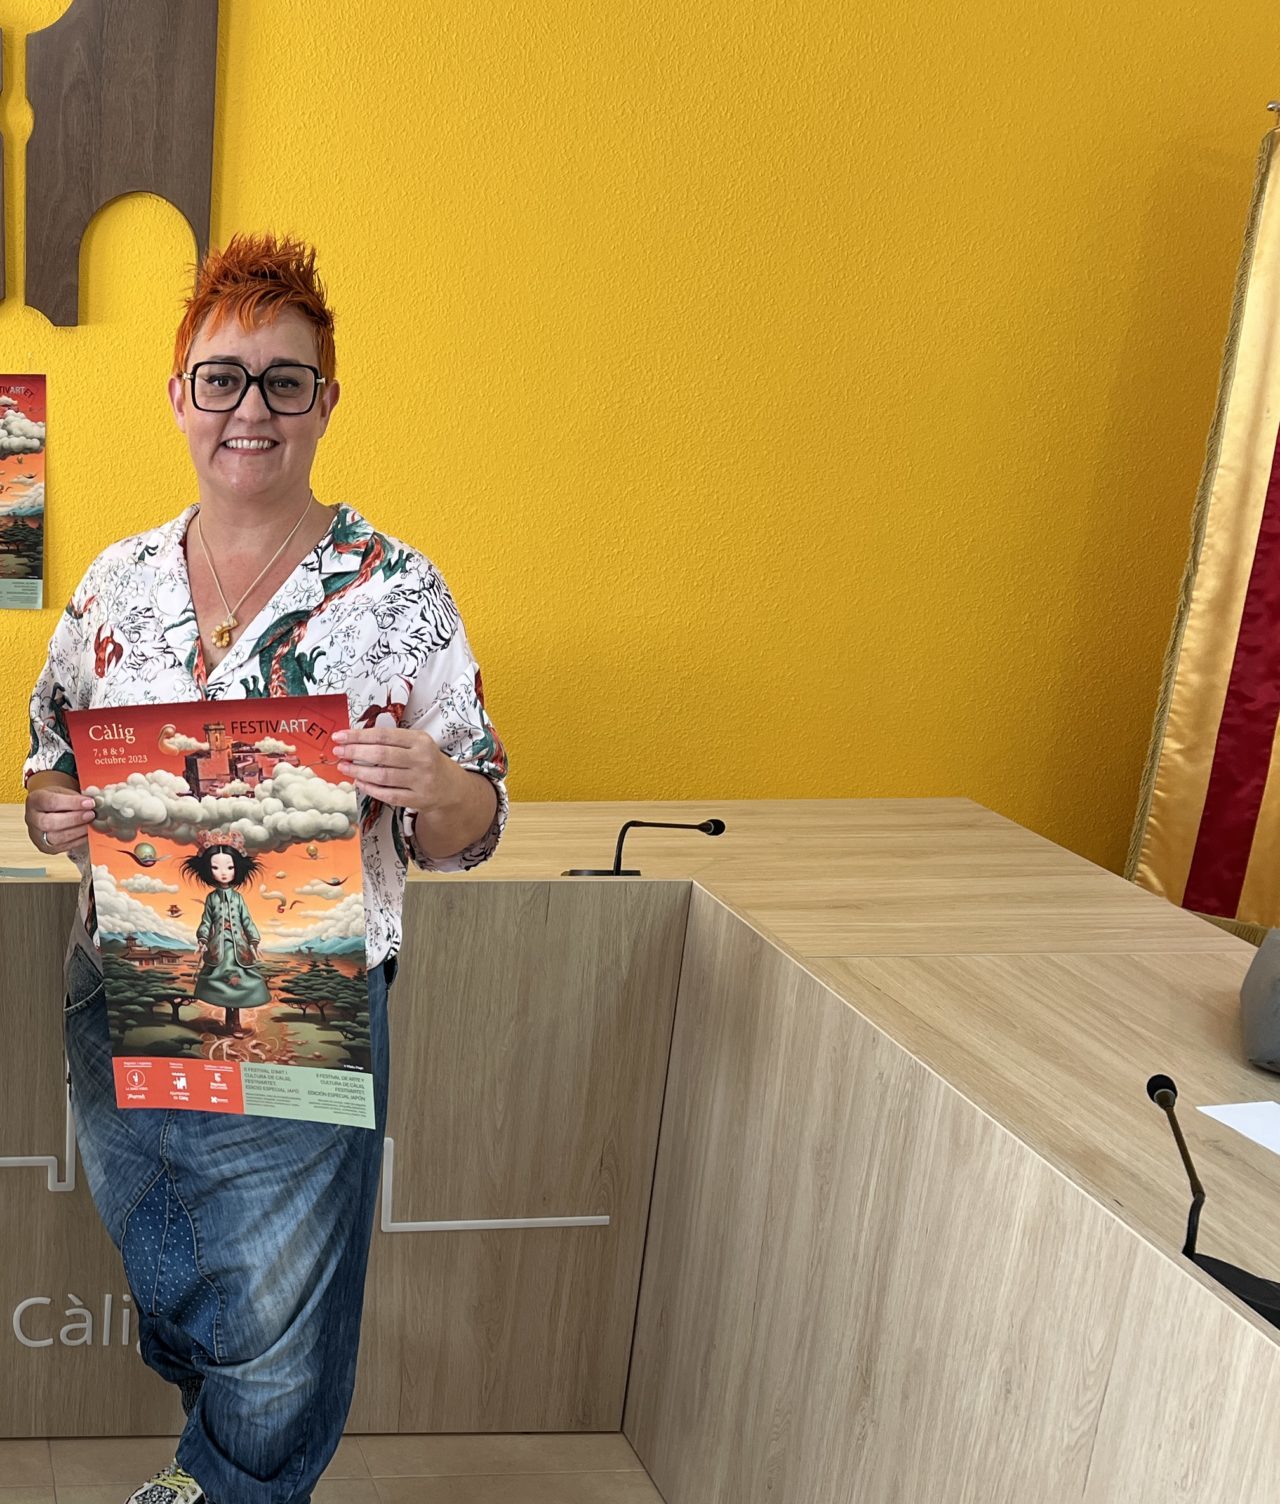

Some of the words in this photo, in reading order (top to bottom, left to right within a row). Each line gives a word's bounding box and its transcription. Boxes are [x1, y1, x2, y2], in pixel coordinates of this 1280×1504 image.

[88, 723, 136, 744] Càlig
[102, 747, 108, 756] 8
[110, 747, 118, 756] &
[119, 746, 125, 755] 9
[95, 755, 126, 765] octubre
[128, 754, 148, 764] 2023
[12, 1293, 141, 1354] Càli
